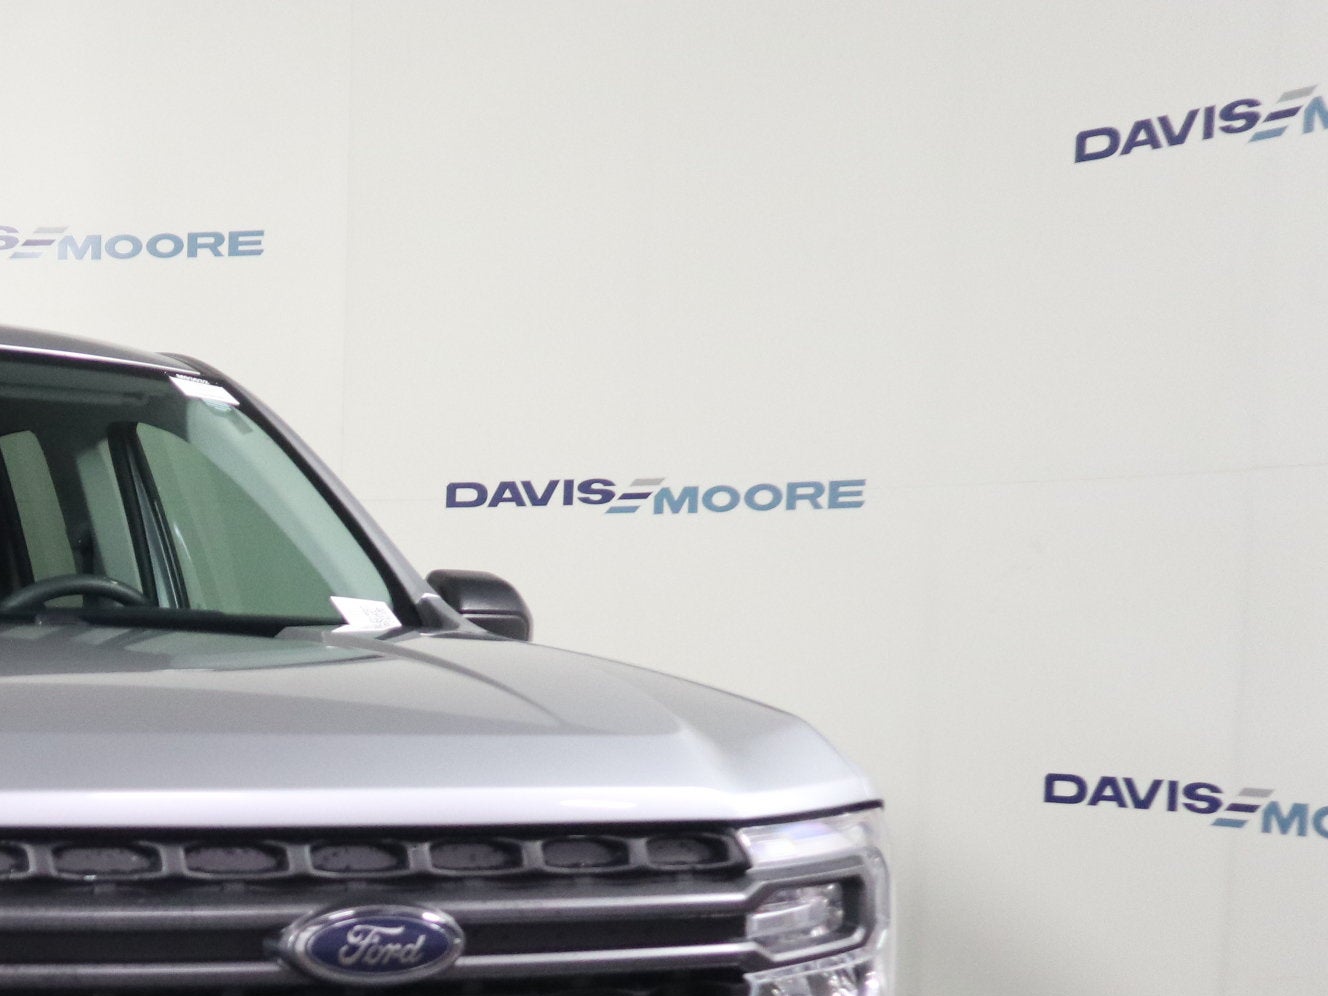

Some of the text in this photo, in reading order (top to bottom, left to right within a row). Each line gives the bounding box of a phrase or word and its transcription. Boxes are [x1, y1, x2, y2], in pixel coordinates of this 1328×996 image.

[1073, 97, 1262, 164] DAVIS
[57, 230, 265, 261] MOORE
[445, 478, 867, 515] DAVIS MOORE
[1043, 773, 1225, 815] DAVIS
[338, 925, 427, 966] Ford
